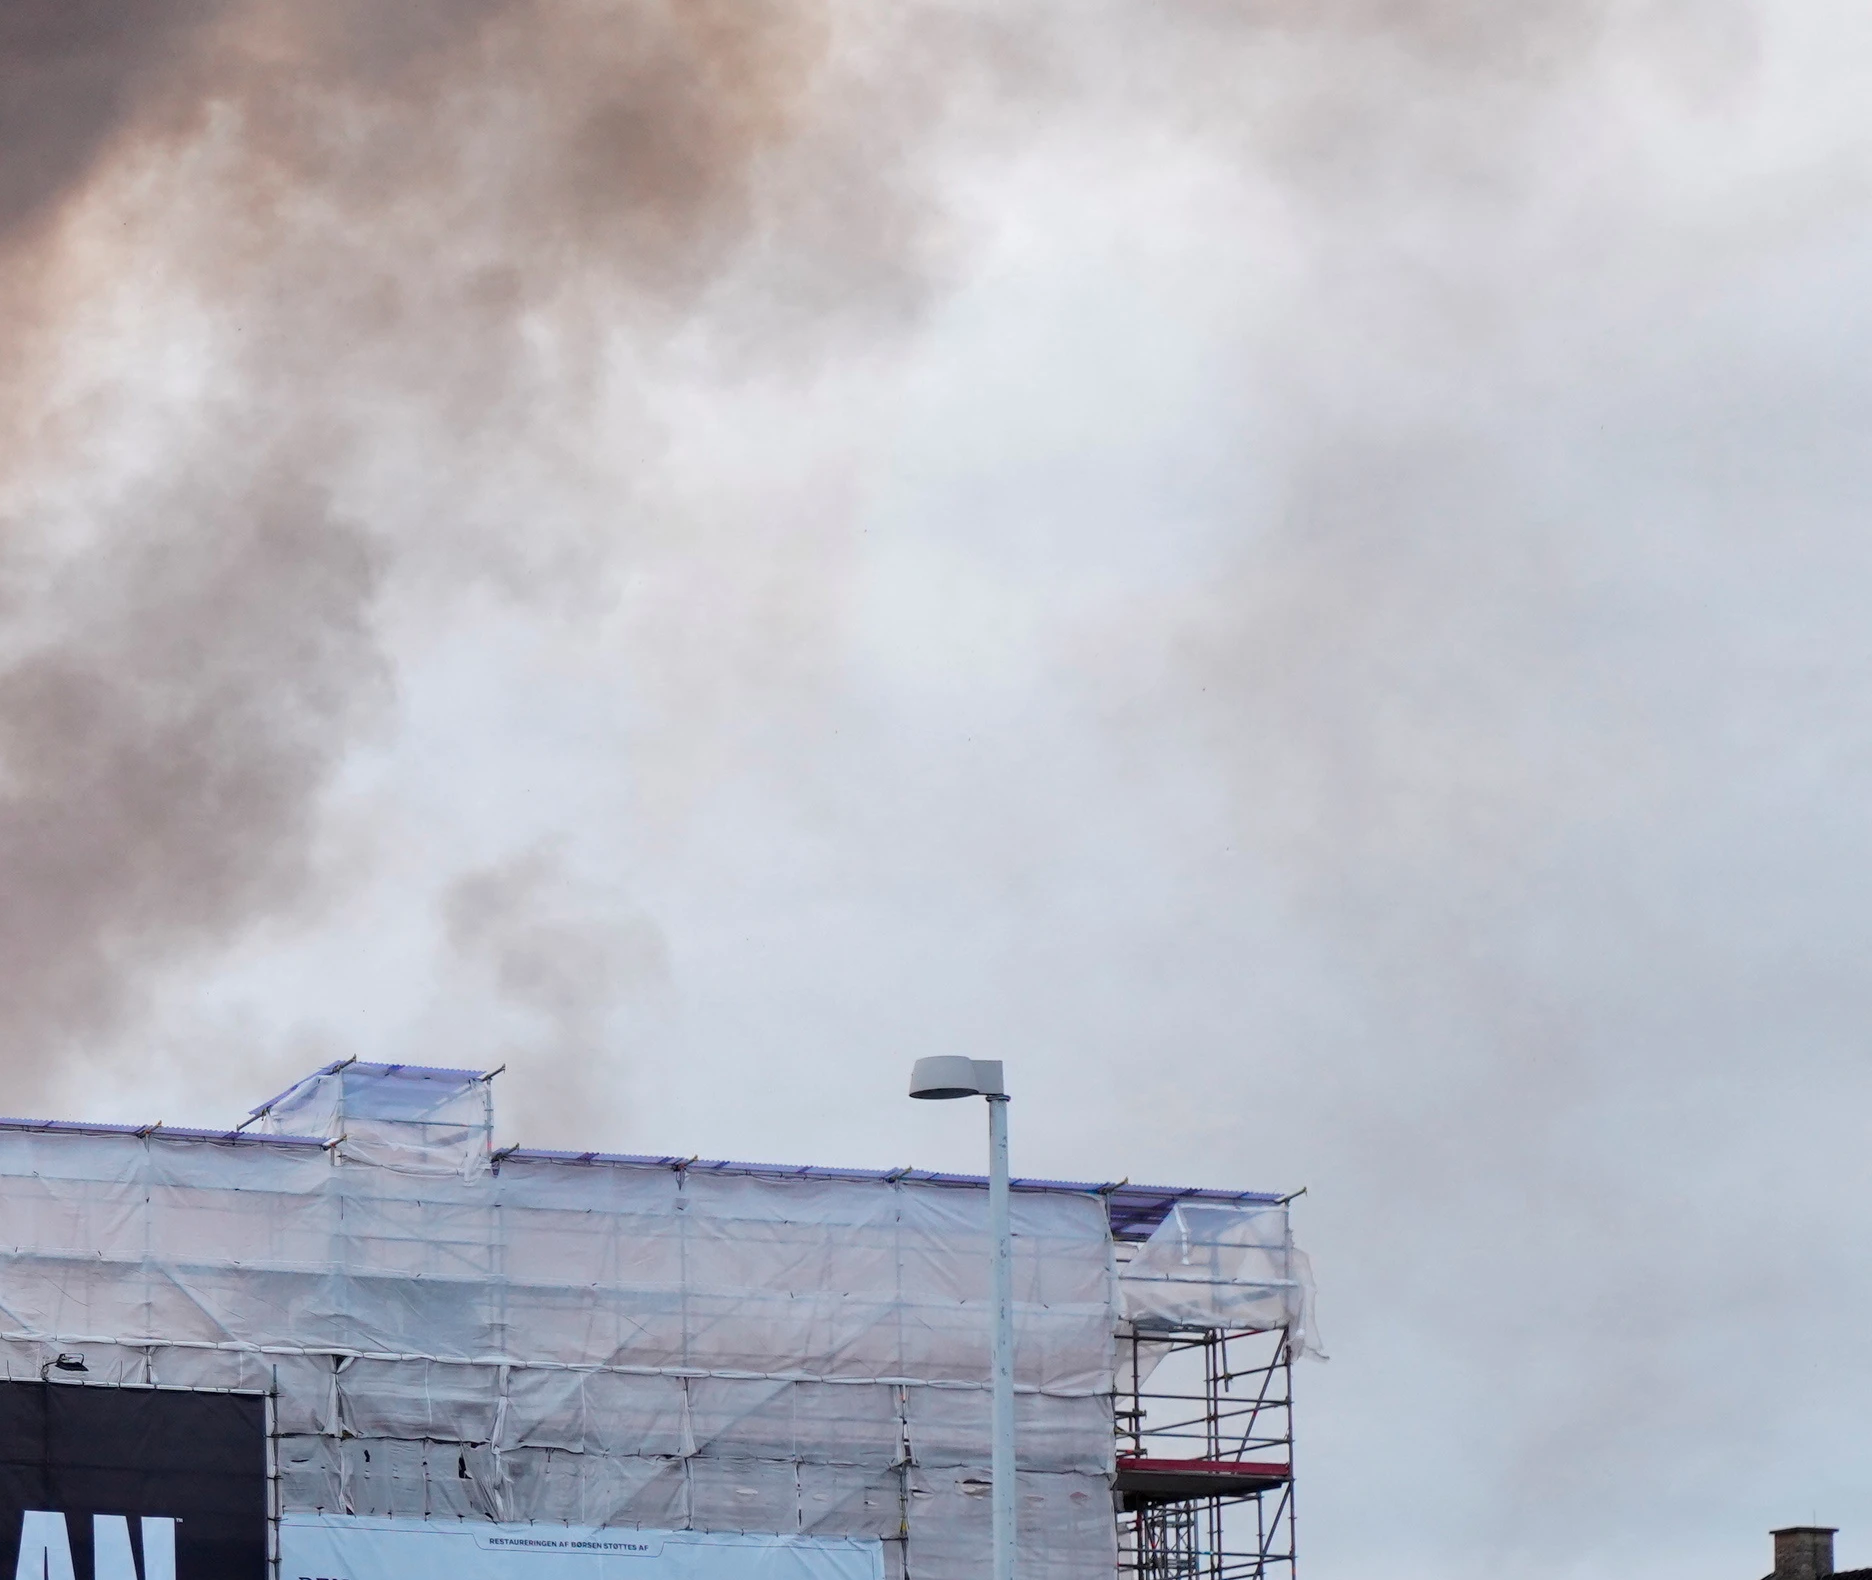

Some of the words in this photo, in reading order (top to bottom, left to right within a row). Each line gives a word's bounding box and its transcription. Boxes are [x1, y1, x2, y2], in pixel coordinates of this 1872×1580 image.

[489, 1537, 557, 1548] RESTAURERINGEN
[571, 1541, 602, 1550] BØRSEN
[604, 1543, 637, 1551] STØTTES
[639, 1544, 649, 1552] AF
